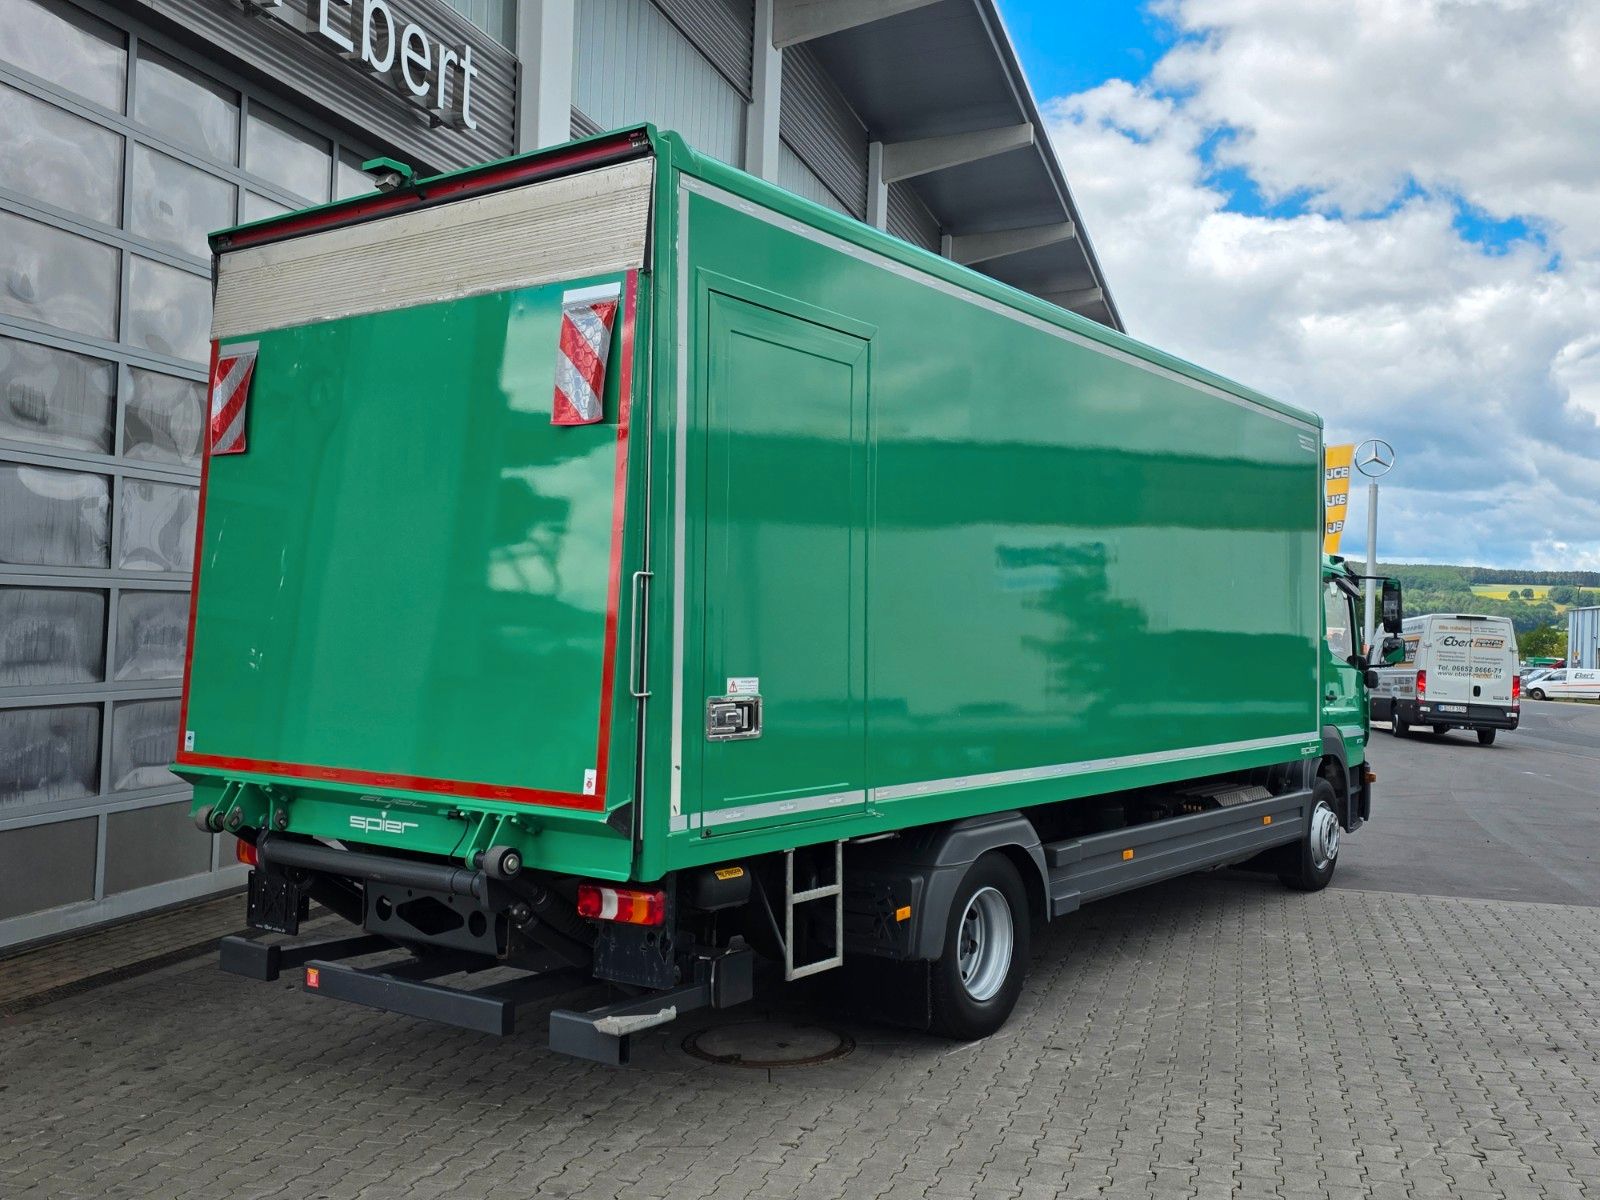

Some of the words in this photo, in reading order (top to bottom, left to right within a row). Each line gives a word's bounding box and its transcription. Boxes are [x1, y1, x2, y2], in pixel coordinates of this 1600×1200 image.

[319, 0, 478, 130] Ebert
[1326, 467, 1349, 480] JCB
[1443, 636, 1473, 648] Ebert
[1574, 672, 1595, 680] Ebert
[350, 811, 419, 834] spier
